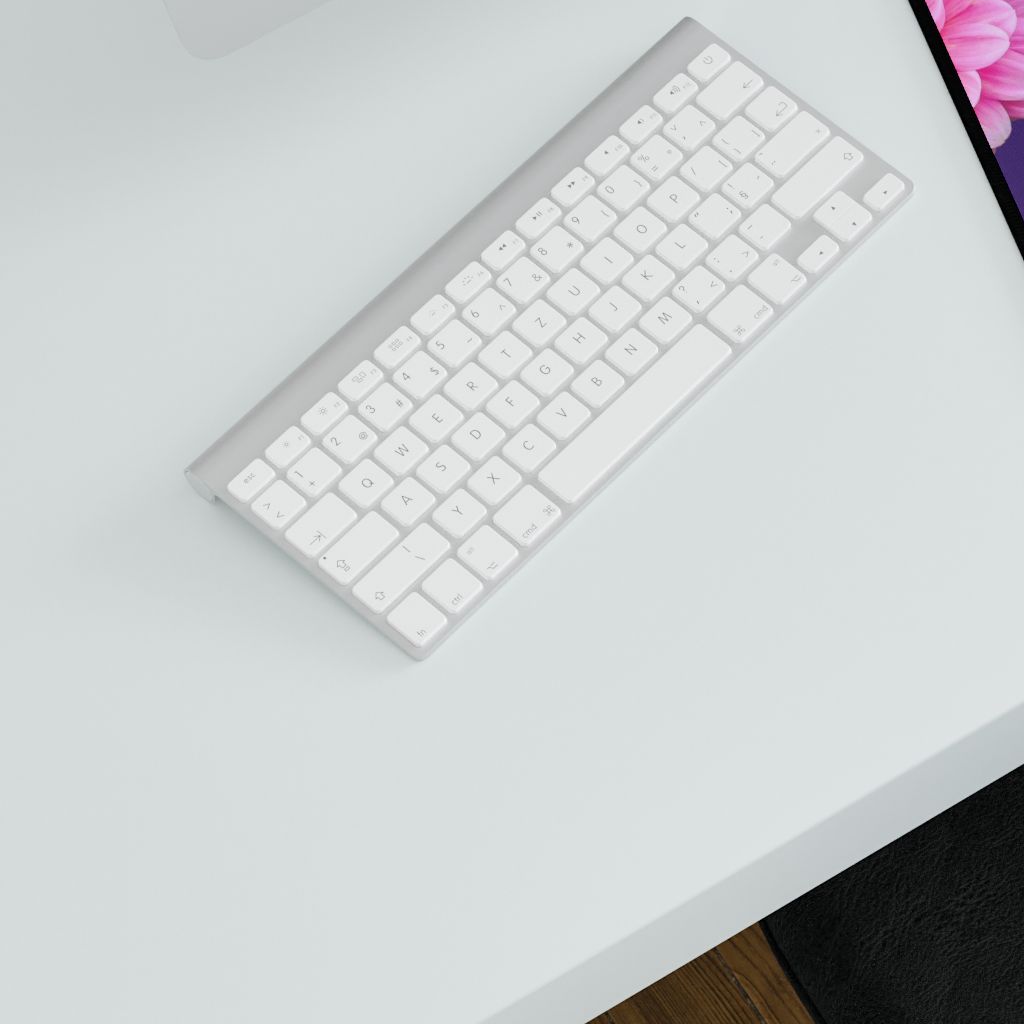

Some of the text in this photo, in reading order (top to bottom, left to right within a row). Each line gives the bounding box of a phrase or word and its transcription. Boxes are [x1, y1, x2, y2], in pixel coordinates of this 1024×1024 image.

[604, 184, 615, 195] 0
[668, 193, 679, 204] P
[571, 216, 580, 225] 9
[636, 224, 648, 234] O
[674, 241, 687, 250] L
[537, 247, 548, 256] 8
[640, 270, 653, 281] K
[502, 277, 512, 287] 7
[567, 285, 580, 297] U
[608, 301, 619, 312] J
[470, 309, 480, 319] 6
[657, 311, 673, 325] M
[534, 316, 548, 329] Z
[571, 331, 587, 344] H
[435, 340, 446, 351] 5
[623, 343, 638, 356] N
[500, 348, 512, 358] T
[539, 364, 551, 375] G
[402, 371, 411, 381] 4
[590, 376, 603, 387] B
[465, 381, 478, 391] R
[504, 396, 515, 408] F
[365, 404, 376, 414] 3
[431, 412, 444, 424] E
[469, 429, 482, 440] D
[329, 436, 342, 447] 2
[522, 440, 535, 451] C
[393, 443, 409, 457] W
[435, 461, 447, 472] S
[361, 478, 375, 489] Q
[486, 472, 501, 486] X
[401, 495, 414, 507] A
[451, 505, 463, 516] Y
